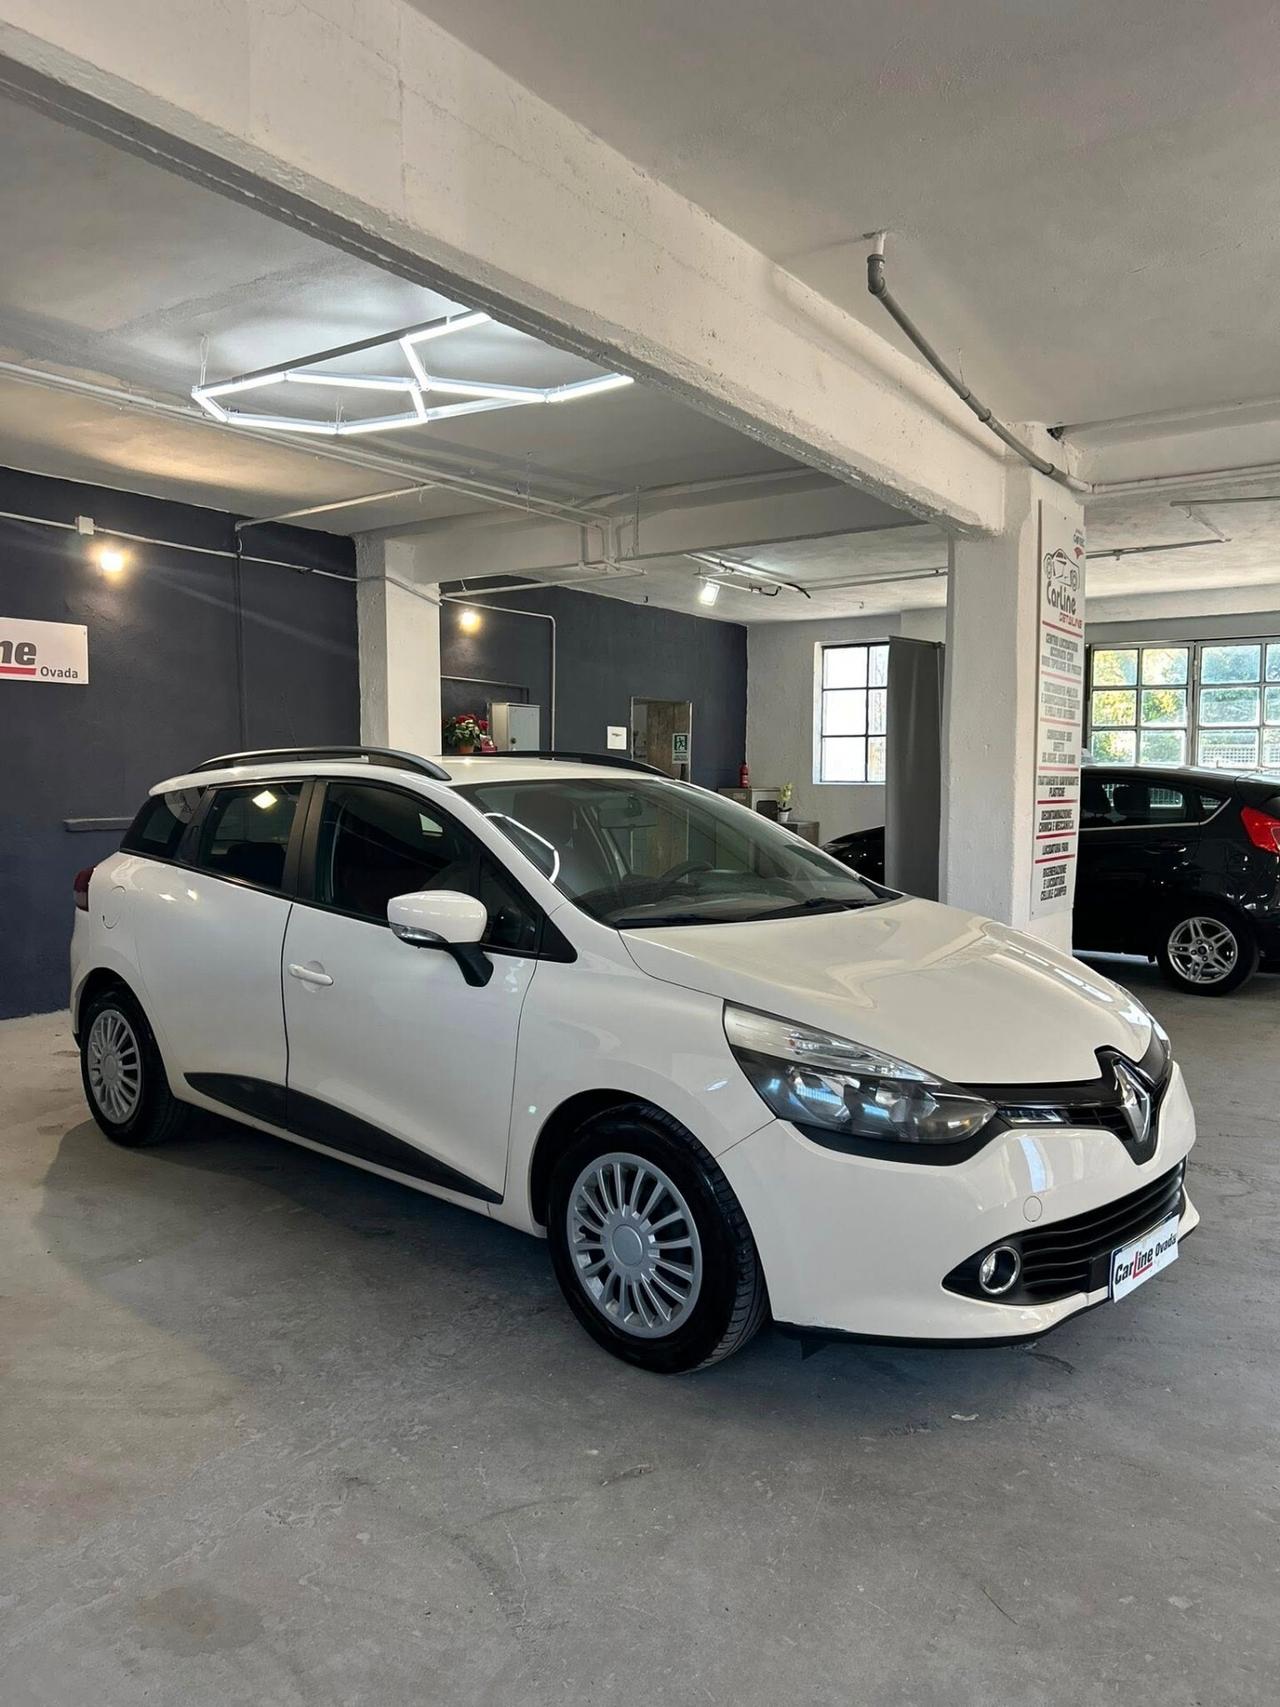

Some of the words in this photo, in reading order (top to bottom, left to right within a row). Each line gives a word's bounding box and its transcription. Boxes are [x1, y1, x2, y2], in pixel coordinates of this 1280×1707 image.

[1047, 581, 1076, 615] CarLine
[40, 665, 79, 679] Ovada
[1114, 1248, 1154, 1285] CarLine
[1154, 1233, 1177, 1257] Ovada
